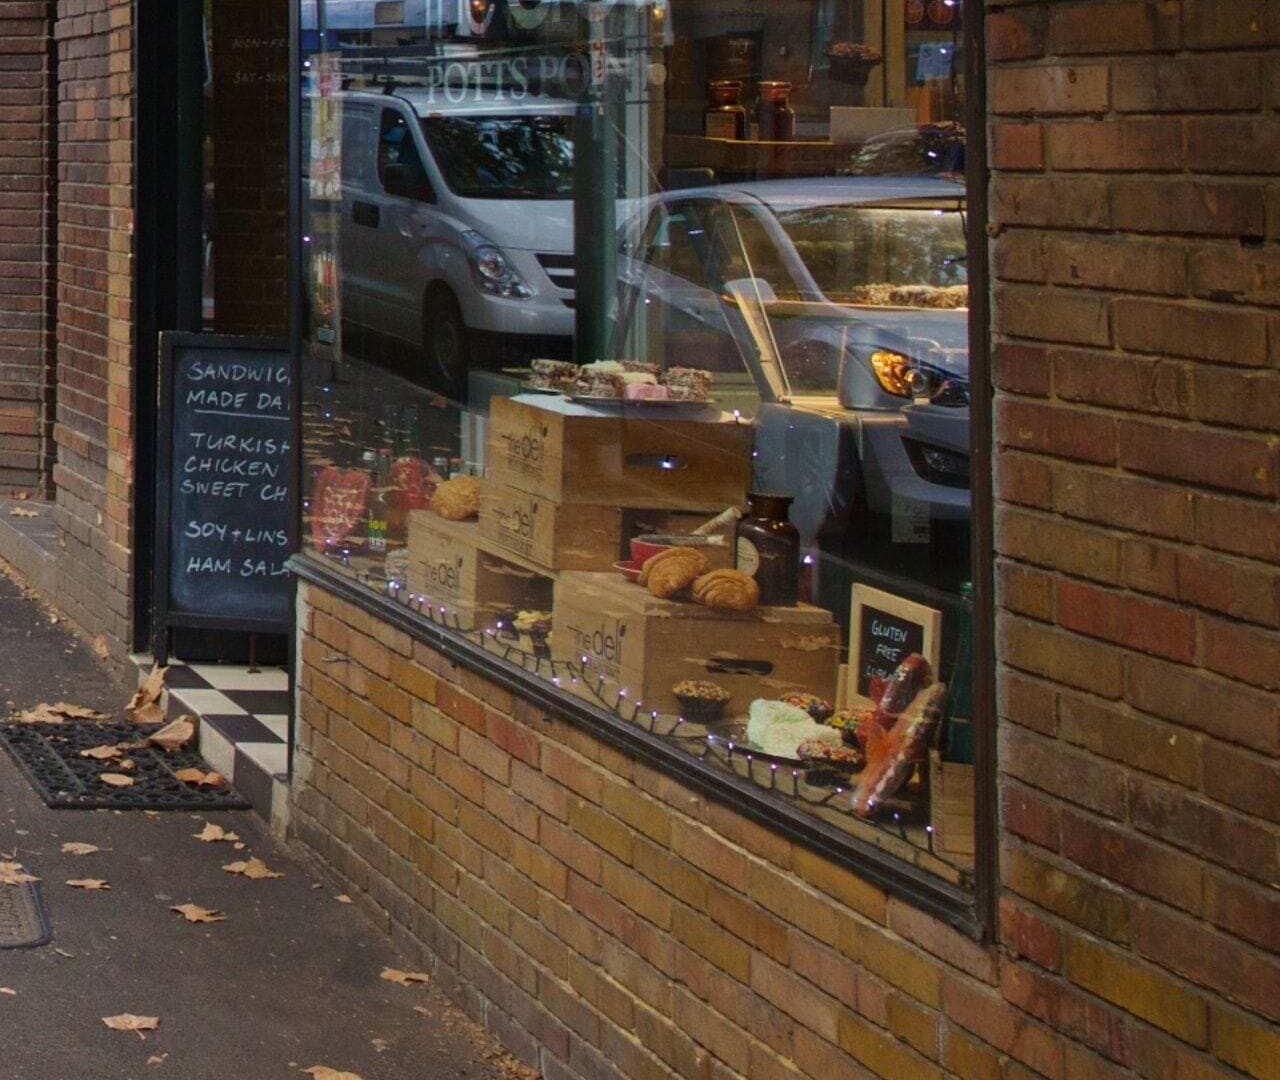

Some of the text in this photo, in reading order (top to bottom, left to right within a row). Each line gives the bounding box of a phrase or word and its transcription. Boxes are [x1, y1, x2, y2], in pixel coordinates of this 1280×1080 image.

[427, 54, 527, 105] POTTS
[186, 362, 290, 385] SANDWIC
[186, 389, 248, 408] MADE
[184, 456, 279, 478] CHICKEN
[179, 480, 249, 498] SWEET
[186, 557, 231, 574] HAM
[871, 619, 908, 643] GLUTEN
[875, 644, 903, 662] FREE
